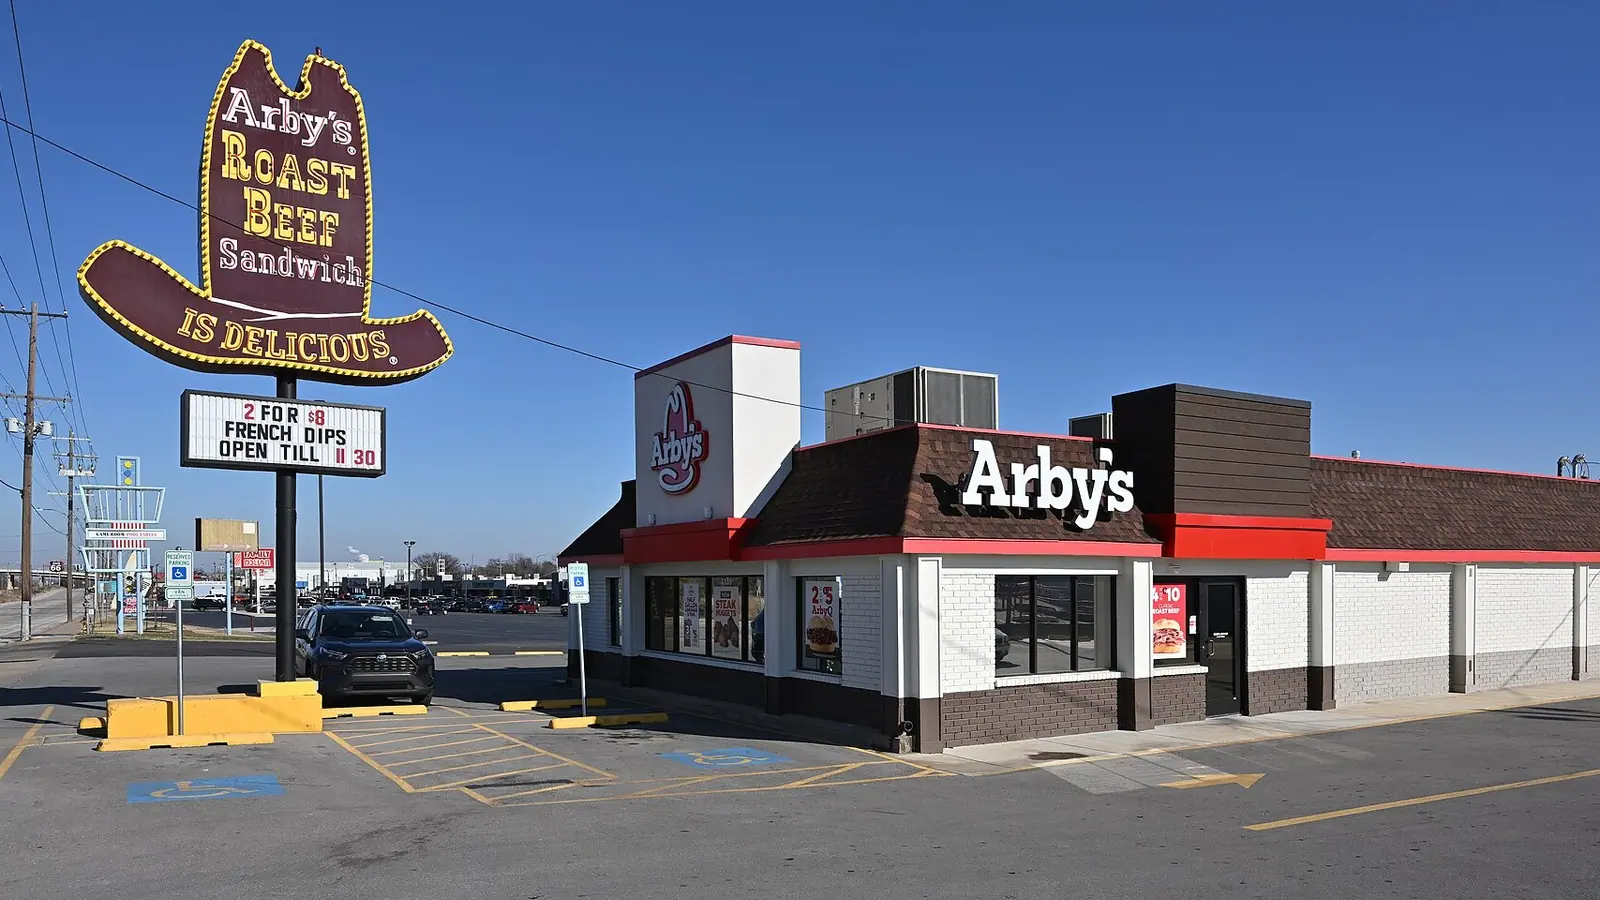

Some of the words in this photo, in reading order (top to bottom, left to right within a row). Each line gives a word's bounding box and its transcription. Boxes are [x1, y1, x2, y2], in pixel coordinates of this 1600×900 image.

[222, 87, 352, 147] Arby's
[222, 129, 356, 199] ROAST
[244, 186, 339, 247] BEEF
[219, 238, 364, 287] Sandwich
[177, 307, 217, 343] IS
[219, 320, 390, 363] DELICIOUS
[244, 403, 255, 420] 2
[261, 404, 298, 423] FOR
[308, 409, 325, 426] $8
[225, 421, 291, 442] FRENCH
[305, 427, 346, 446] DIPS
[651, 423, 703, 469] Arby's
[219, 440, 267, 460] OPEN
[280, 444, 319, 462] TILL
[353, 449, 375, 466] 30
[963, 439, 1134, 529] Arby's
[244, 550, 271, 558] FAMILY
[716, 600, 736, 609] STEAK
[812, 586, 819, 604] 2
[812, 605, 833, 617] ArbyQ
